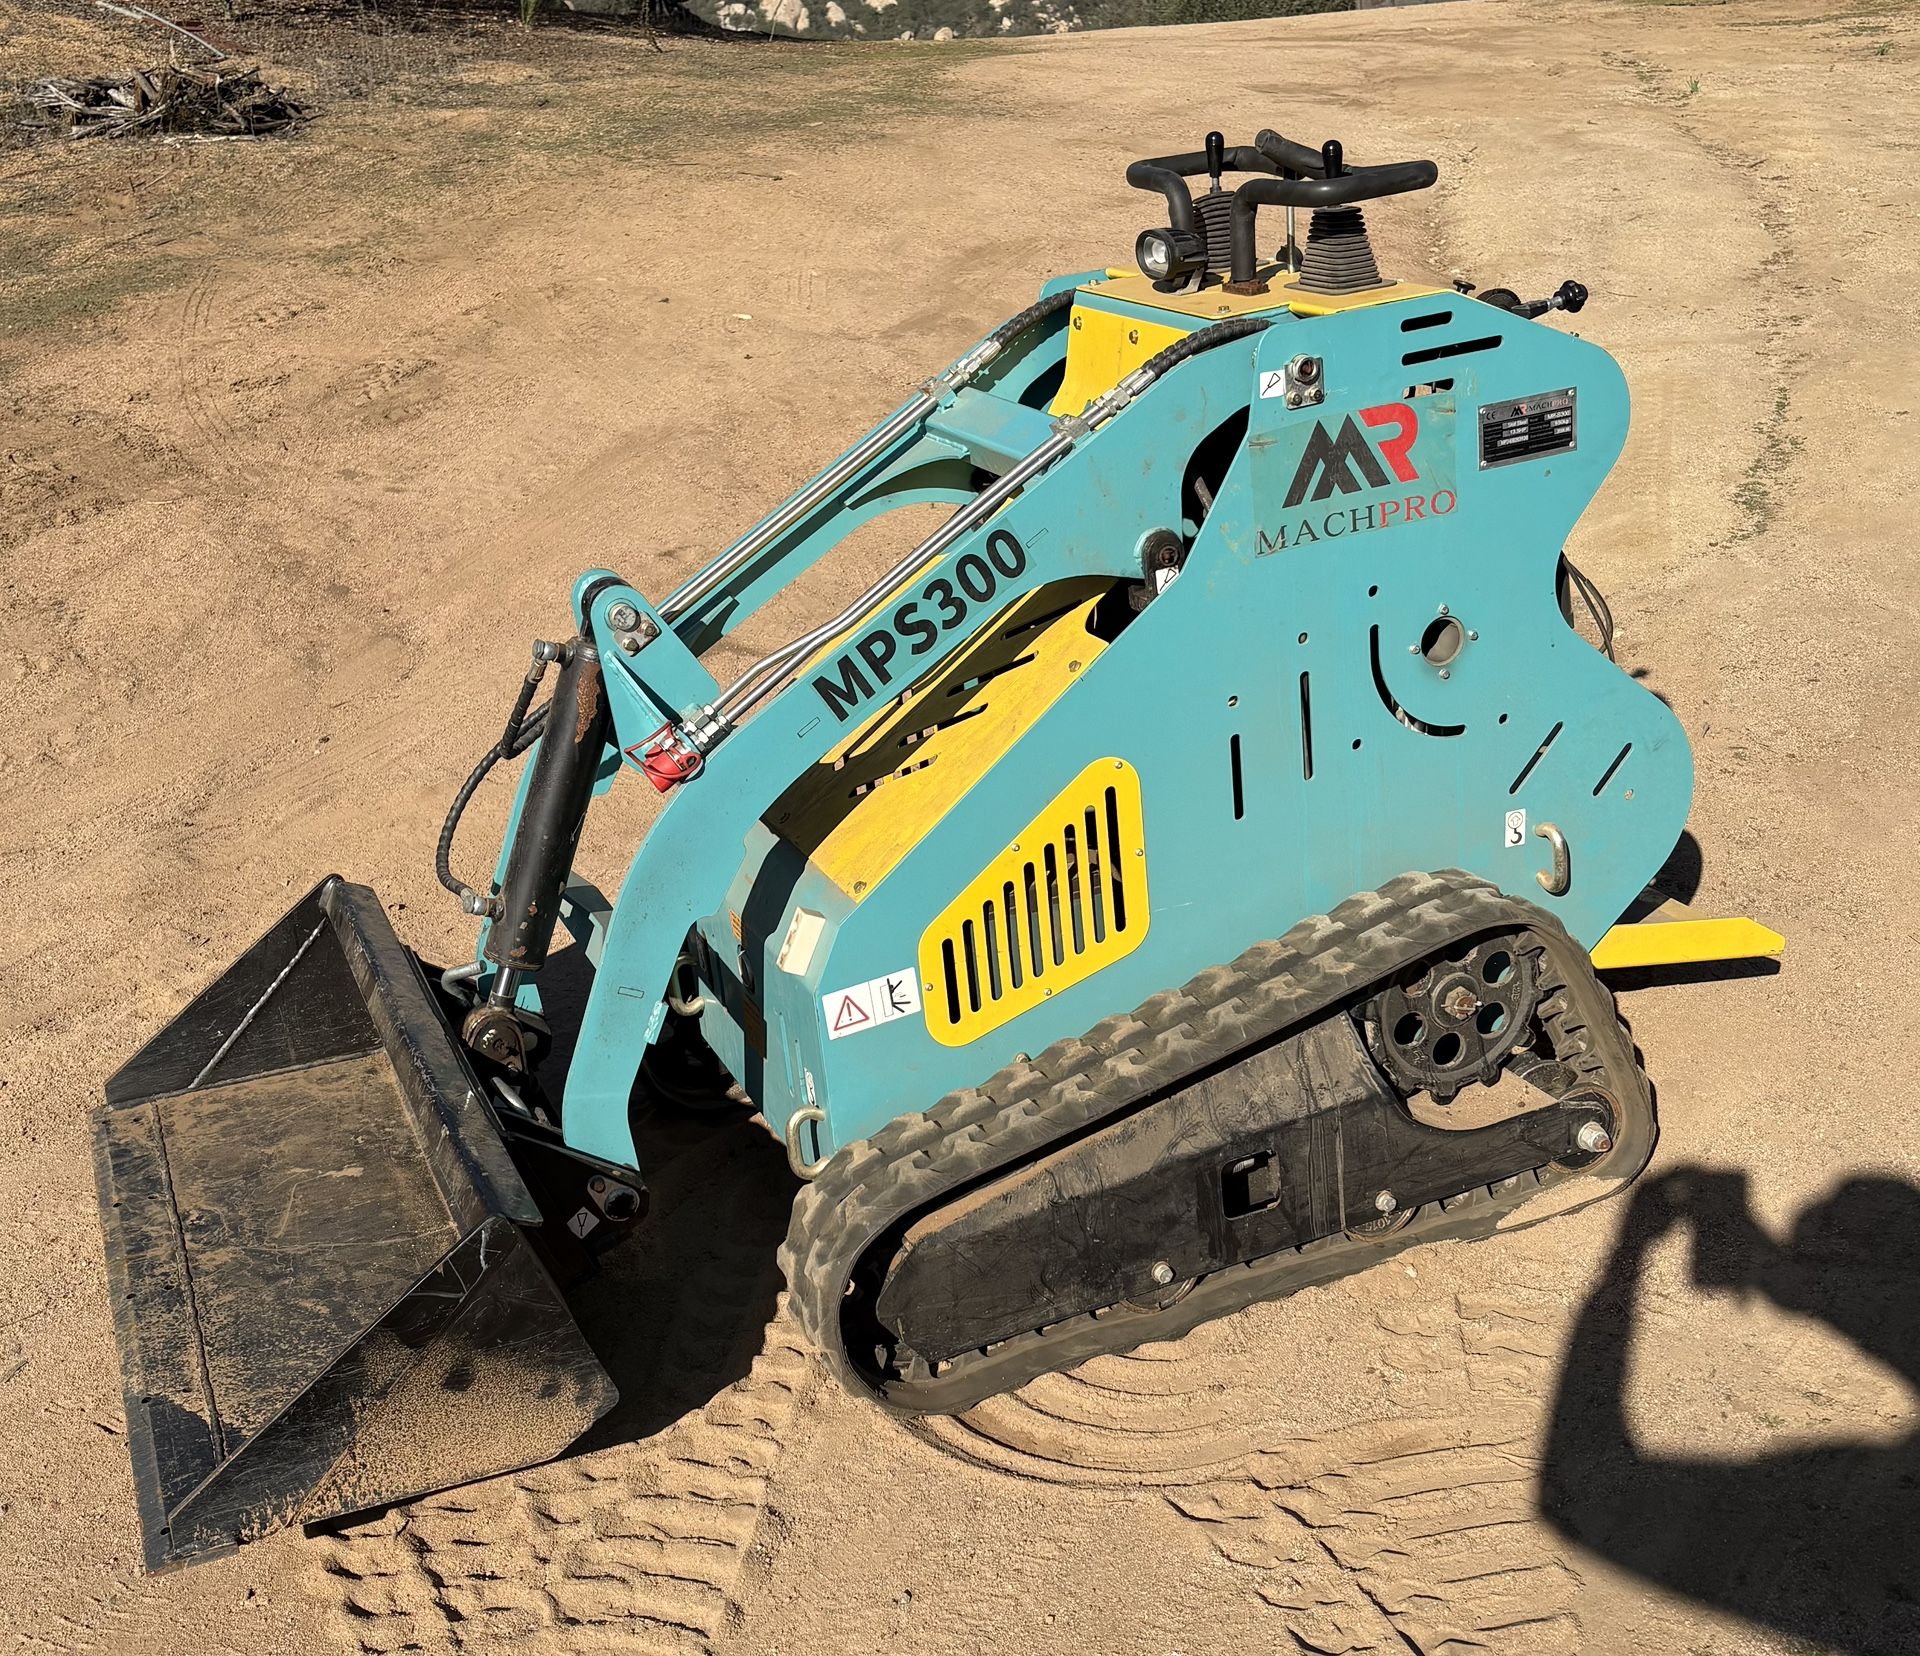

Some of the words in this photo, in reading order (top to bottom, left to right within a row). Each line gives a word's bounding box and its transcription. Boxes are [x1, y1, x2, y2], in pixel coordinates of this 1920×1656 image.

[1486, 411, 1496, 421] CE
[1528, 397, 1569, 412] MACHPRO
[1256, 489, 1457, 556] MACHPRO
[811, 528, 1027, 723] MPS300
